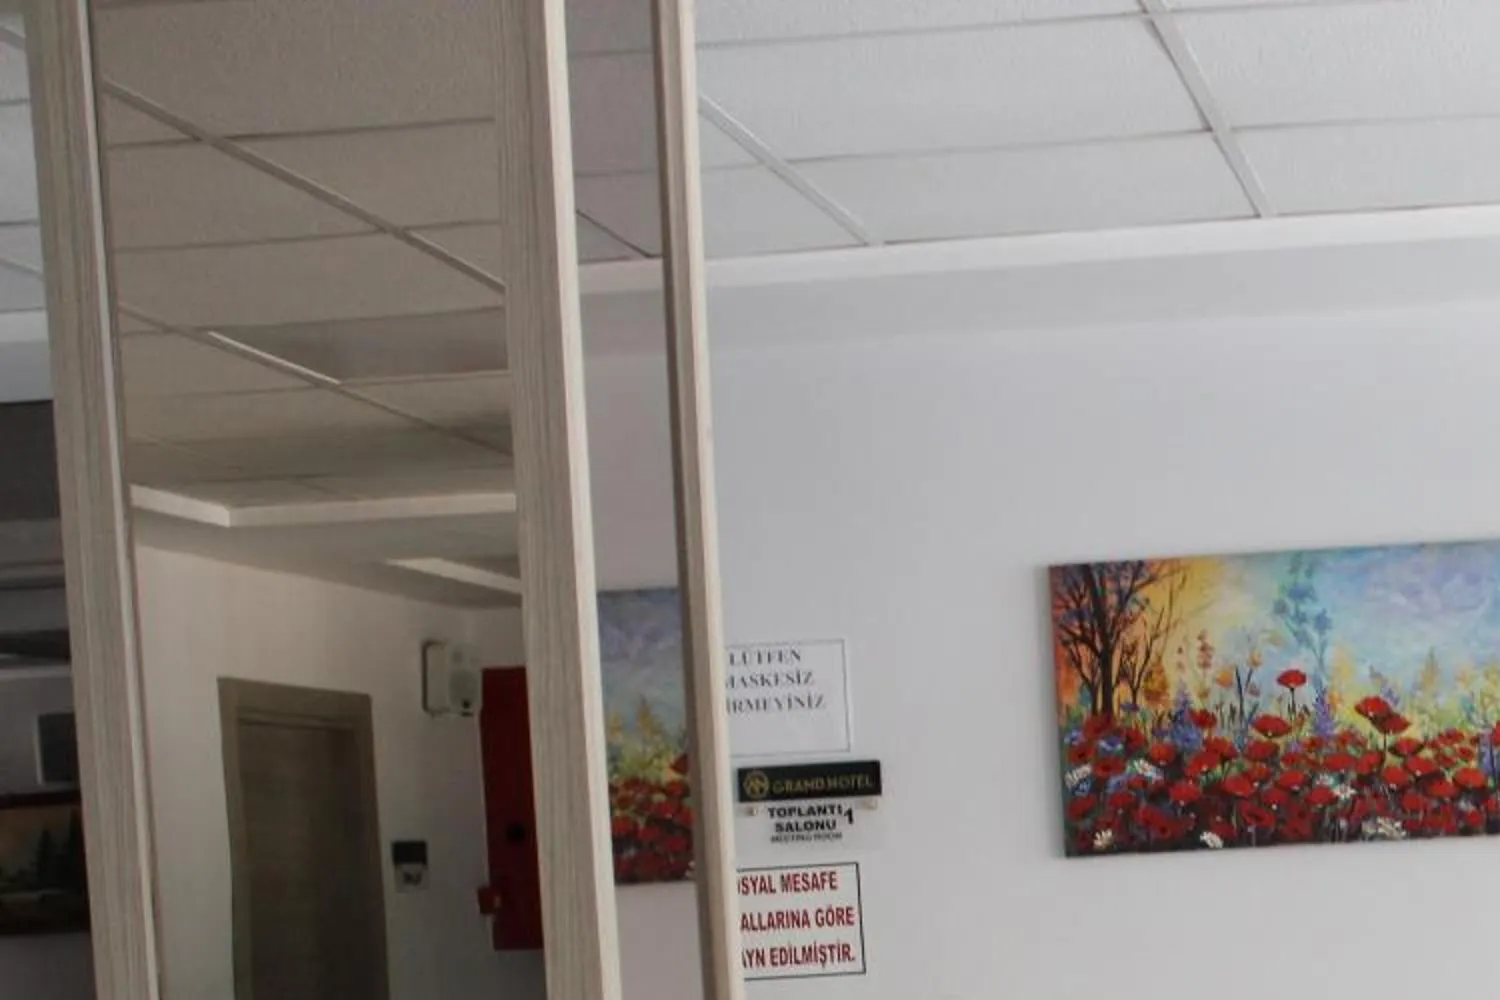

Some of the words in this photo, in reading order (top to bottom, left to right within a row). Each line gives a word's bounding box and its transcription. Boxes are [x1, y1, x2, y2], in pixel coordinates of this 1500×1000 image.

[772, 778, 824, 796] GRAND
[826, 773, 873, 792] HOTEL
[768, 804, 843, 818] TOPLANTI
[844, 807, 854, 825] 1
[774, 819, 837, 833] SALONU
[737, 875, 776, 895] SYAL
[780, 871, 838, 893] MESAFE
[815, 904, 855, 928] GÖRE
[769, 940, 856, 968] EDİLMİŞTİR.
